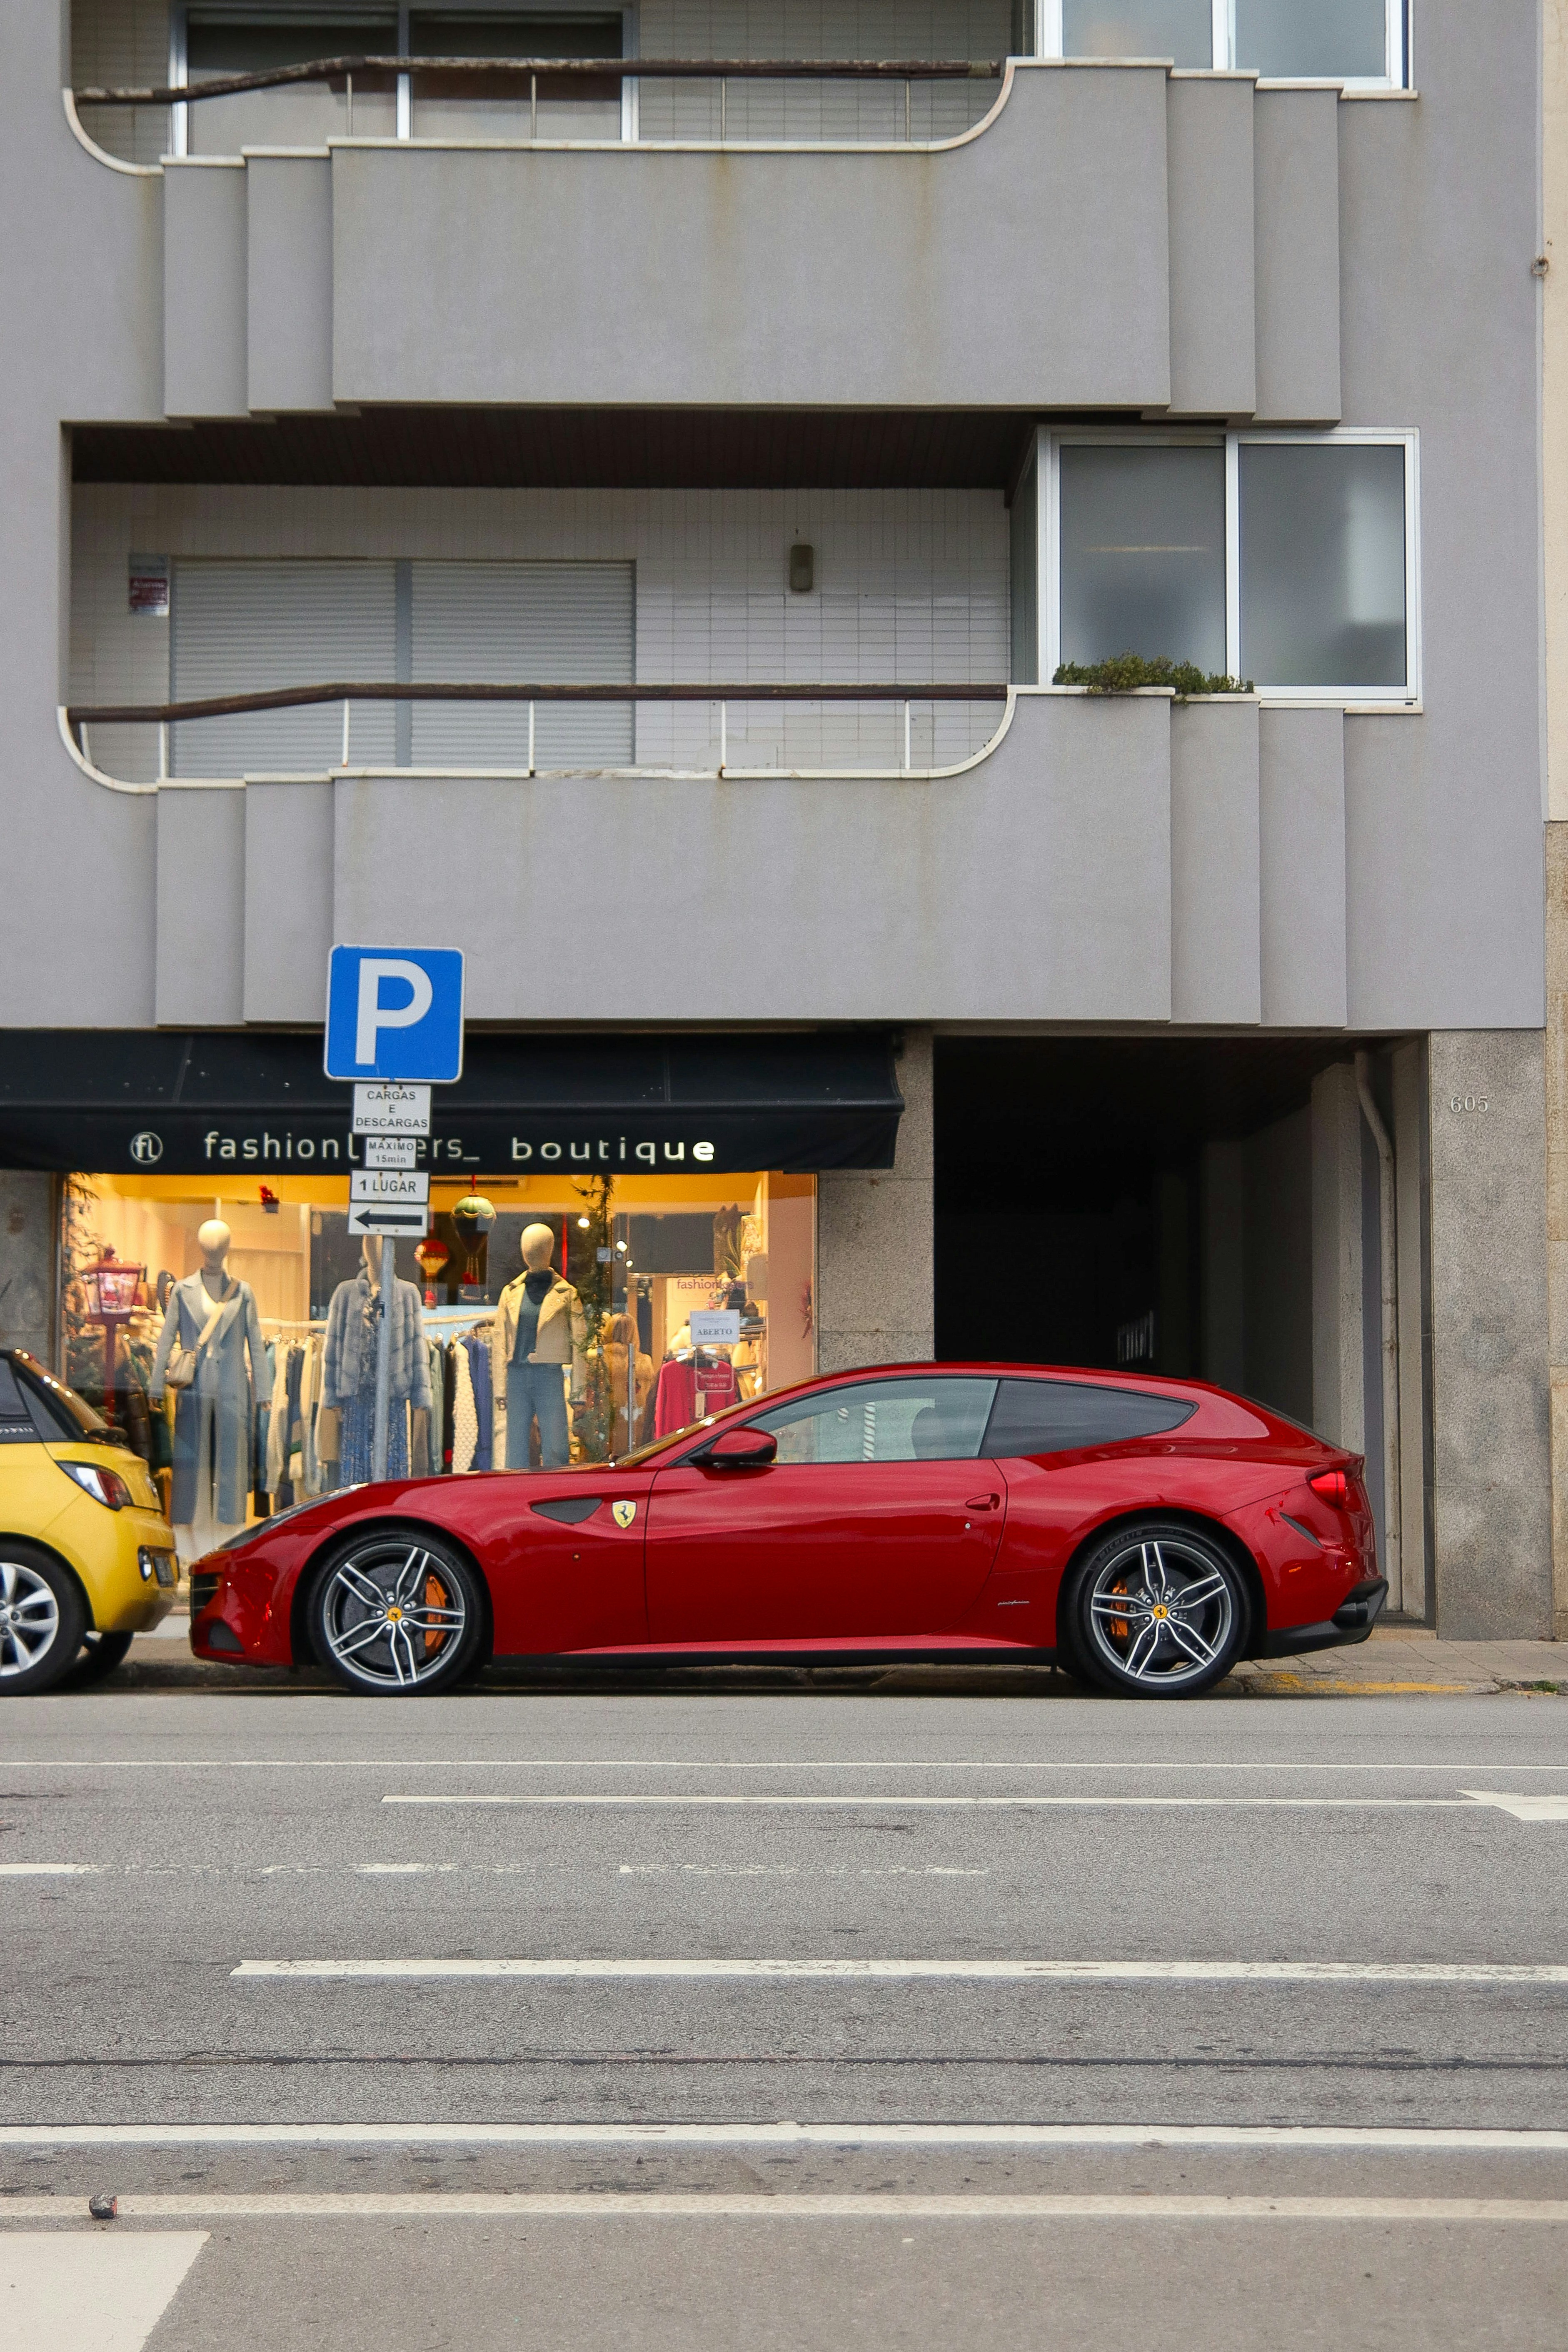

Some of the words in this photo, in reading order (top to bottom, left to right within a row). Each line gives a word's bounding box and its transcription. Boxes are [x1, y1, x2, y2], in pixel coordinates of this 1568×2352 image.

[355, 958, 433, 1065] P
[367, 1091, 416, 1100] CARGAS
[389, 1105, 396, 1113] E
[1451, 1095, 1488, 1113] 605
[356, 1117, 428, 1127] DESCARGAS
[204, 1131, 480, 1161] fashionlers_
[512, 1137, 715, 1165] boutique
[376, 1155, 406, 1163] 15min
[360, 1180, 367, 1192] 1
[372, 1180, 416, 1192] LUGAR
